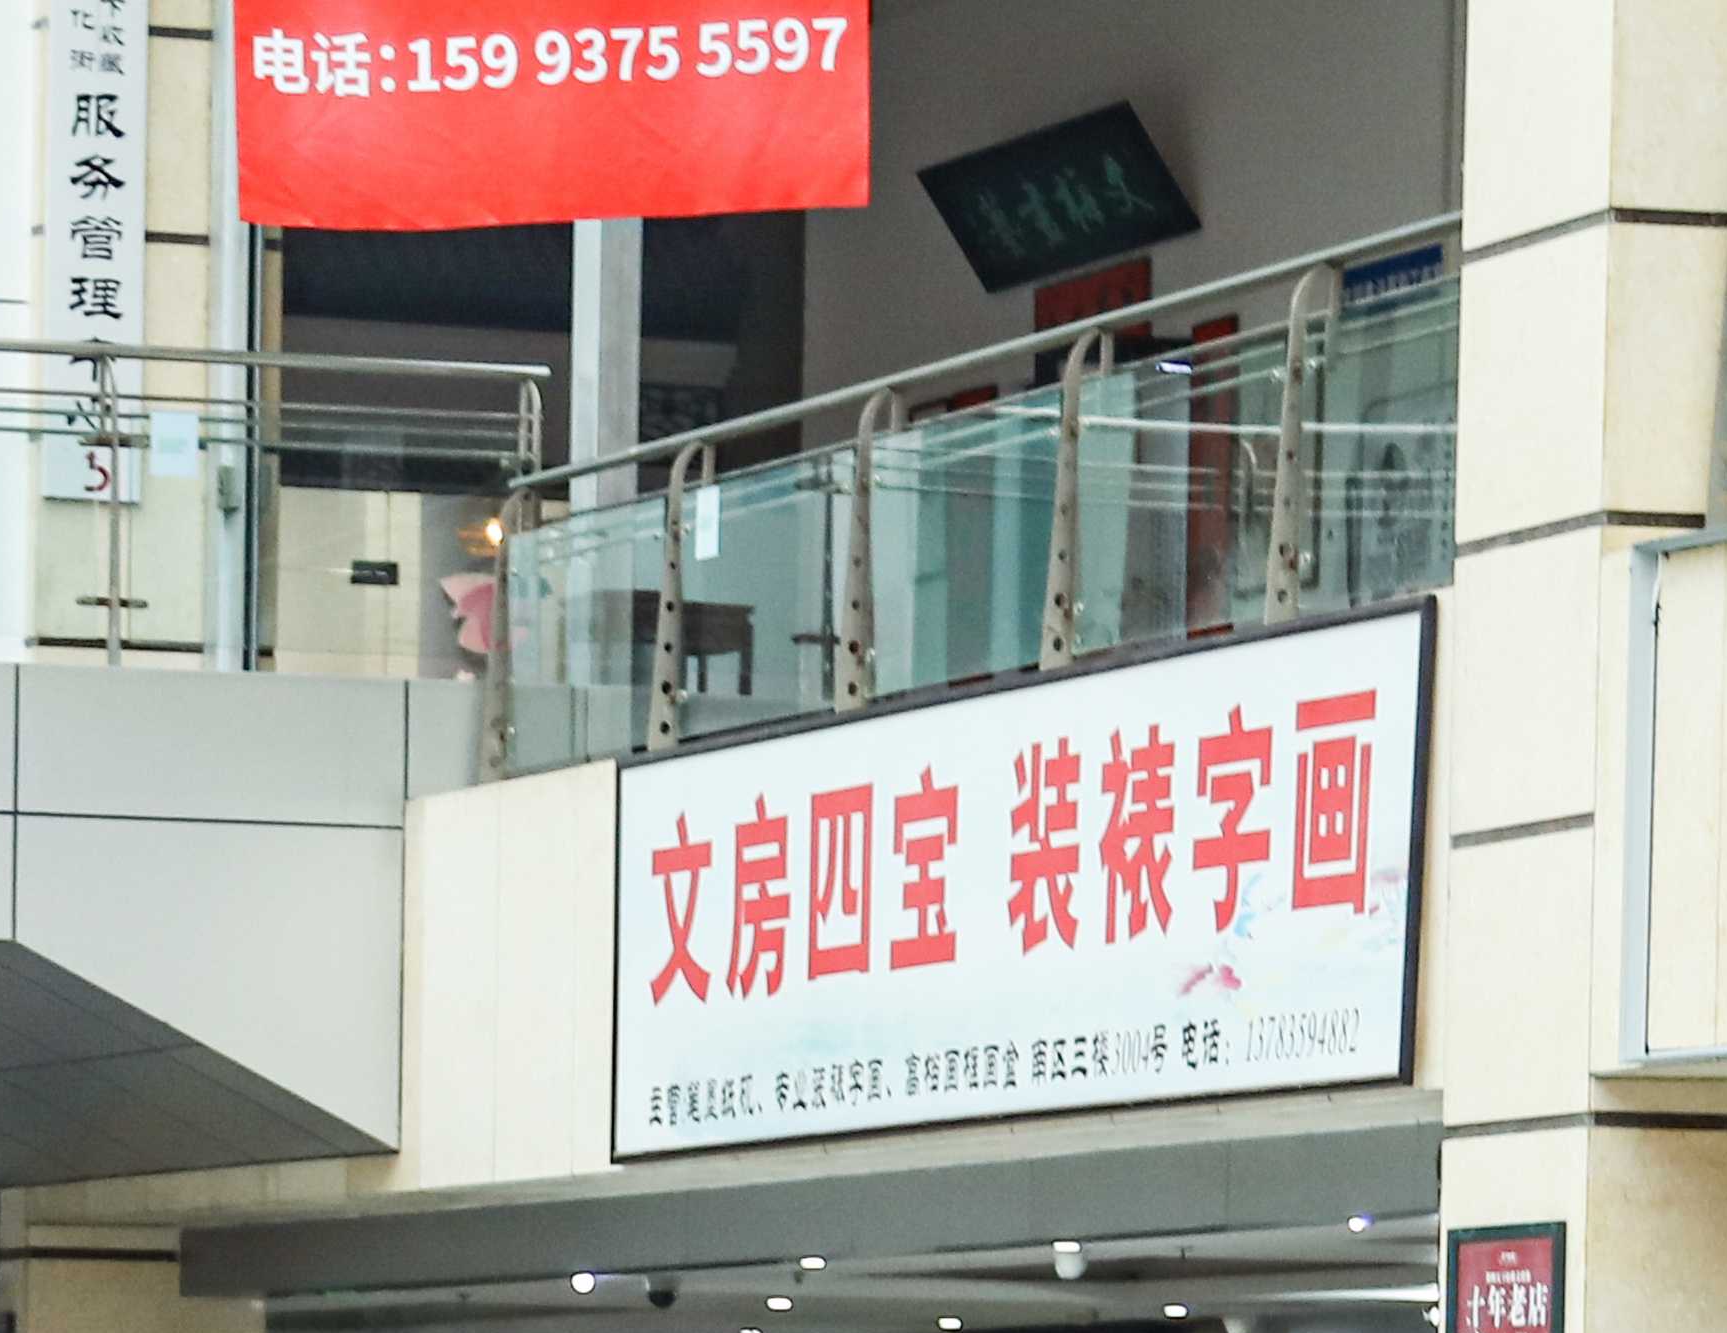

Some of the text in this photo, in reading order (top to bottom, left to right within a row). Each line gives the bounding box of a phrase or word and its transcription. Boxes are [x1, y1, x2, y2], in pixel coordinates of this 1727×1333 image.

[533, 24, 681, 86] 9375
[696, 16, 850, 79] 5597
[650, 688, 1379, 1006] 文房四宝 装裱字画
[1466, 1282, 1548, 1329] 十年老店
